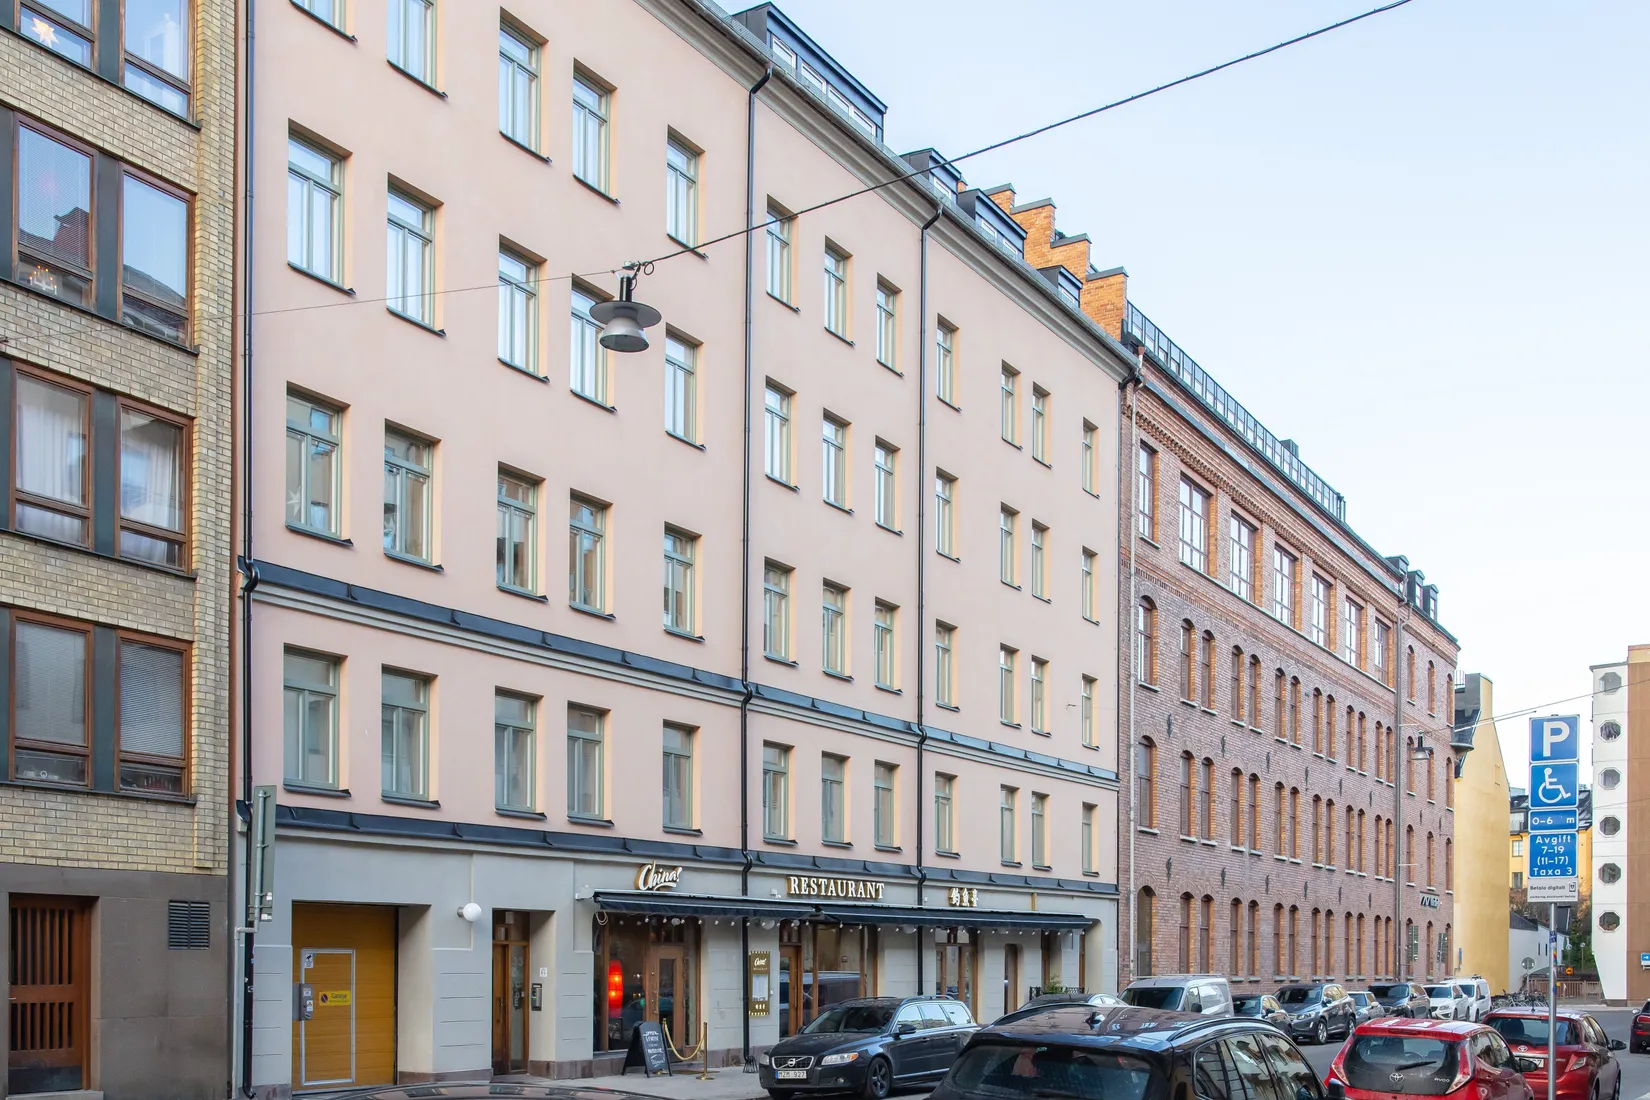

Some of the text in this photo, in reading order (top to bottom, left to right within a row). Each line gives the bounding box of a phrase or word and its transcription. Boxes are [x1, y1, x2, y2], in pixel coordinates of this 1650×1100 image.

[1543, 721, 1570, 757] P
[1532, 817, 1553, 825] 0-6
[1536, 835, 1571, 845] Avgift
[1541, 846, 1565, 854] 7-19
[1537, 855, 1569, 865] (11-17)
[1533, 867, 1573, 876] Taxa 3
[788, 876, 885, 899] RESTAURANT
